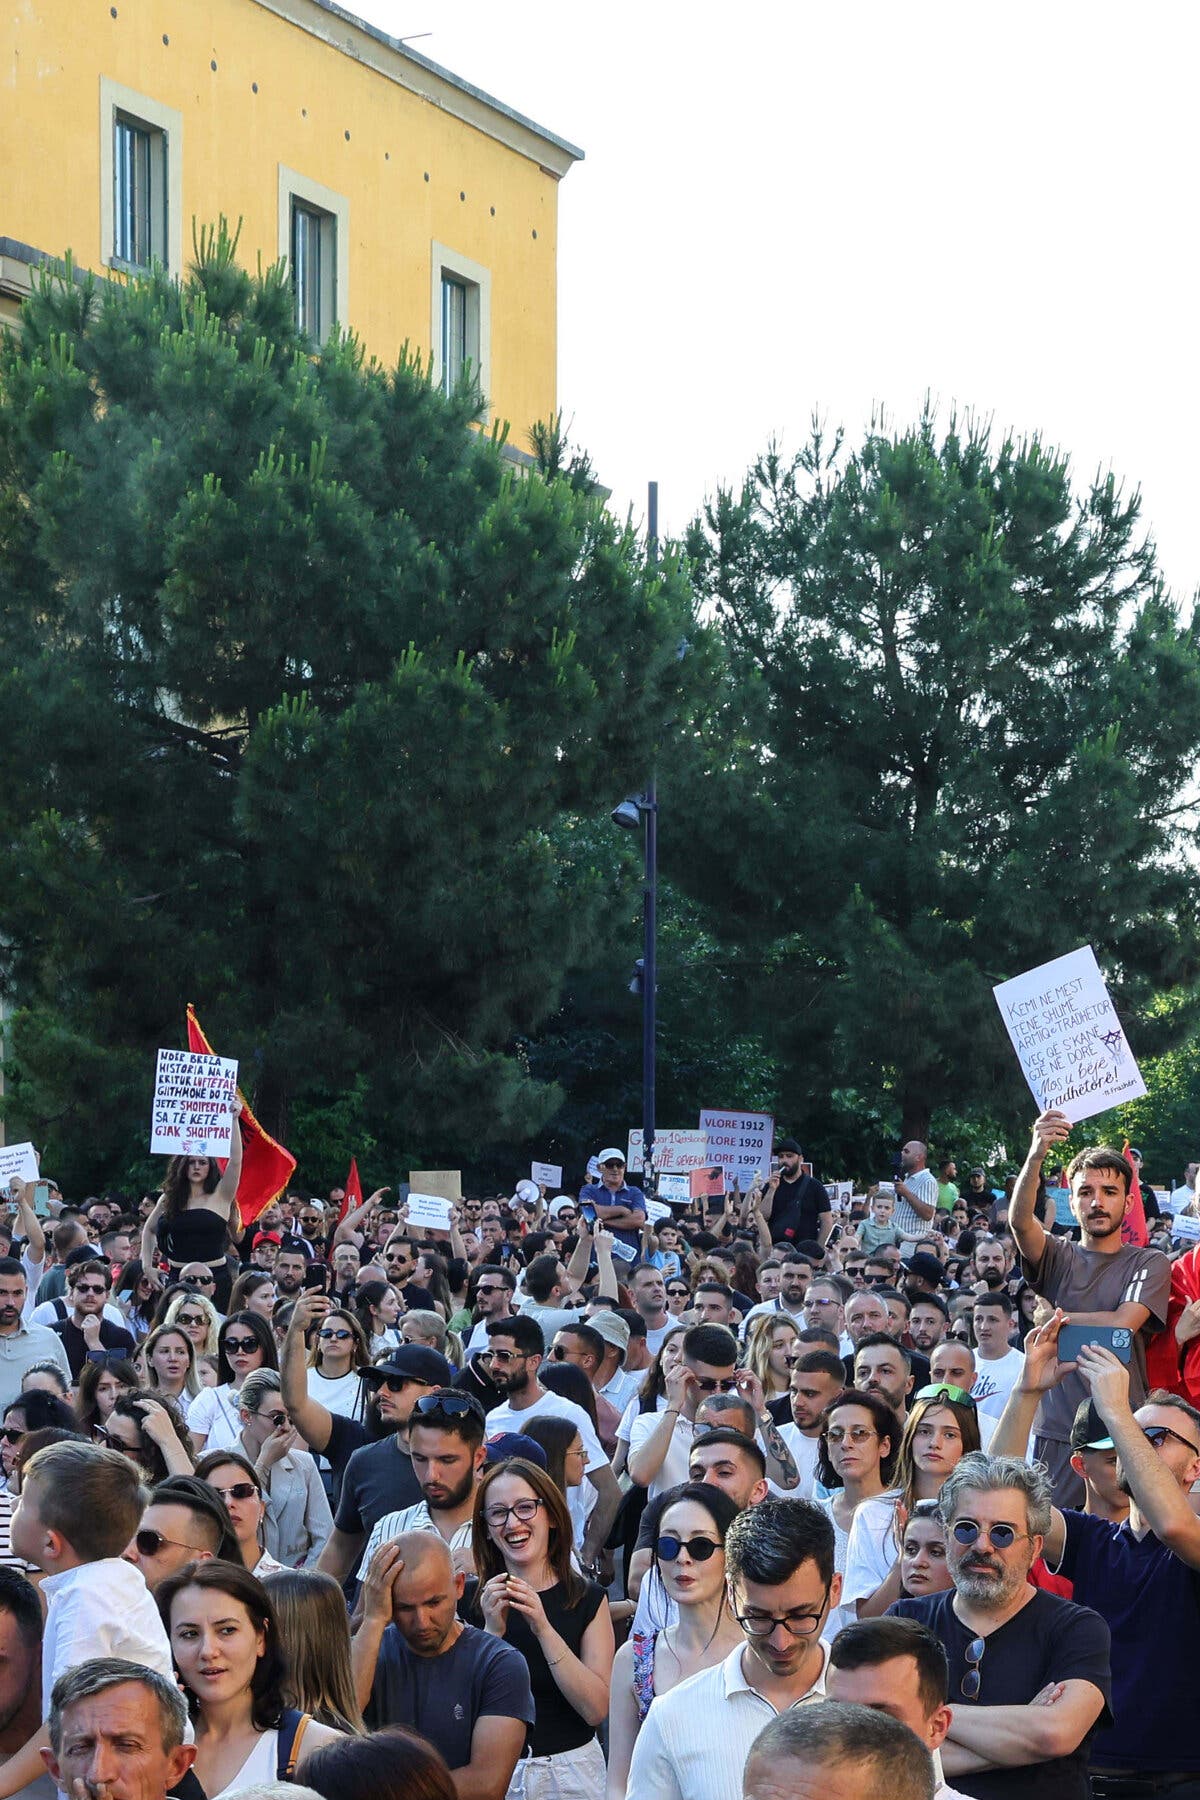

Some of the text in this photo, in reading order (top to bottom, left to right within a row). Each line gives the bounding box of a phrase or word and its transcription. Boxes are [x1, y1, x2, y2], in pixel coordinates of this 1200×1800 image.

[1007, 999, 1038, 1022] KEMI
[160, 1063, 204, 1075] HISTORIA
[209, 1089, 220, 1099] DO
[155, 1111, 168, 1123] SA
[705, 1118, 765, 1131] VLORE 1912
[155, 1125, 231, 1139] GJAK SHQIPTAR
[739, 1138, 764, 1149] 1920
[738, 1155, 762, 1166] 1997
